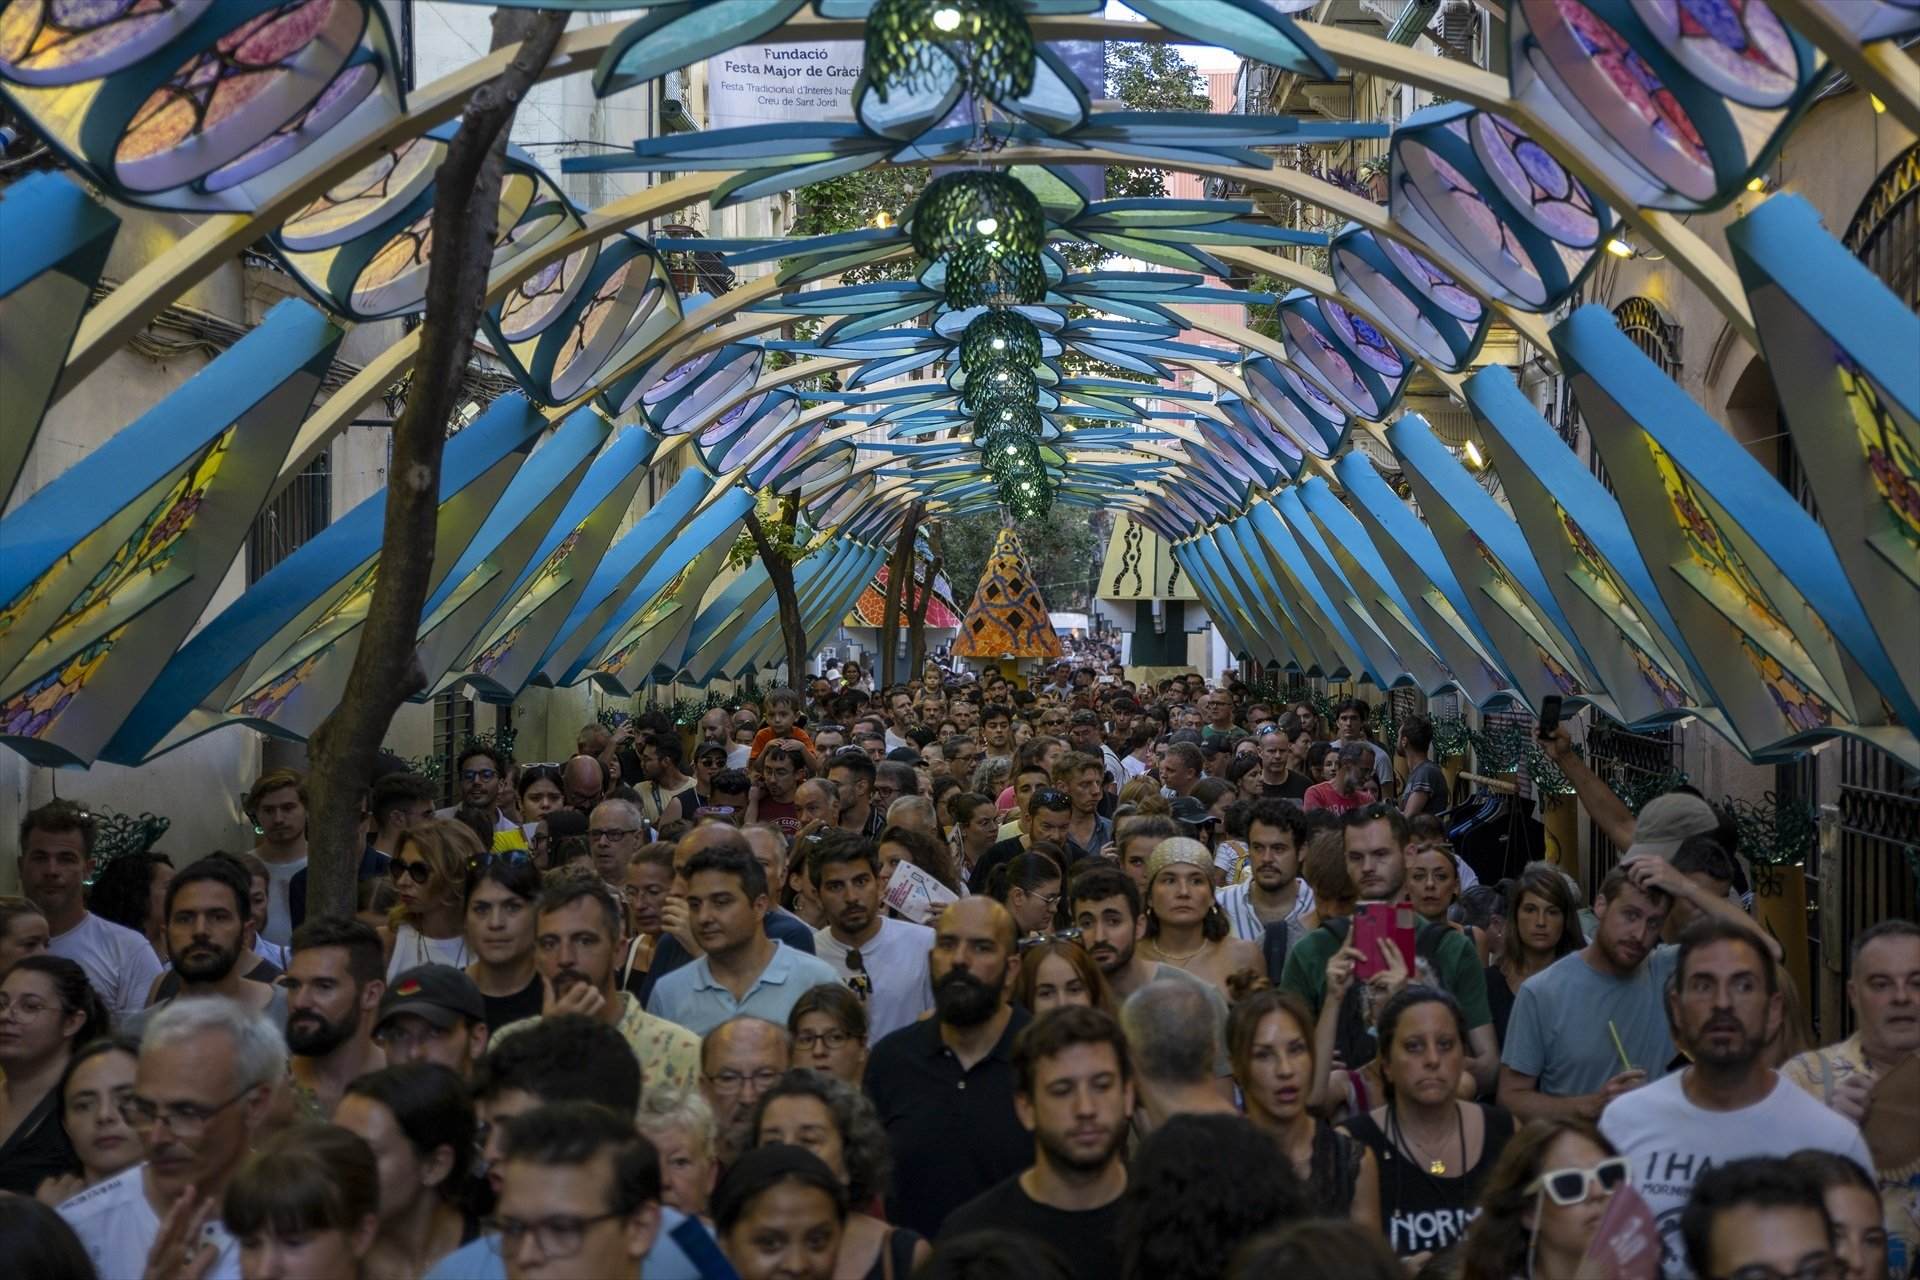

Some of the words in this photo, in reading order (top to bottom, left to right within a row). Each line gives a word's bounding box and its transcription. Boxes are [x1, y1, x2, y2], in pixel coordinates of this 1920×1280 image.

[764, 48, 828, 60] Fundació
[725, 60, 760, 74] Festa
[763, 64, 802, 79] Major
[806, 65, 823, 77] de
[721, 81, 744, 91] Festa
[746, 83, 795, 94] Tradicional
[835, 86, 852, 96] Nac
[757, 95, 780, 105] Creu
[781, 96, 794, 106] de
[795, 97, 815, 106] Sant
[816, 98, 838, 107] Jordi
